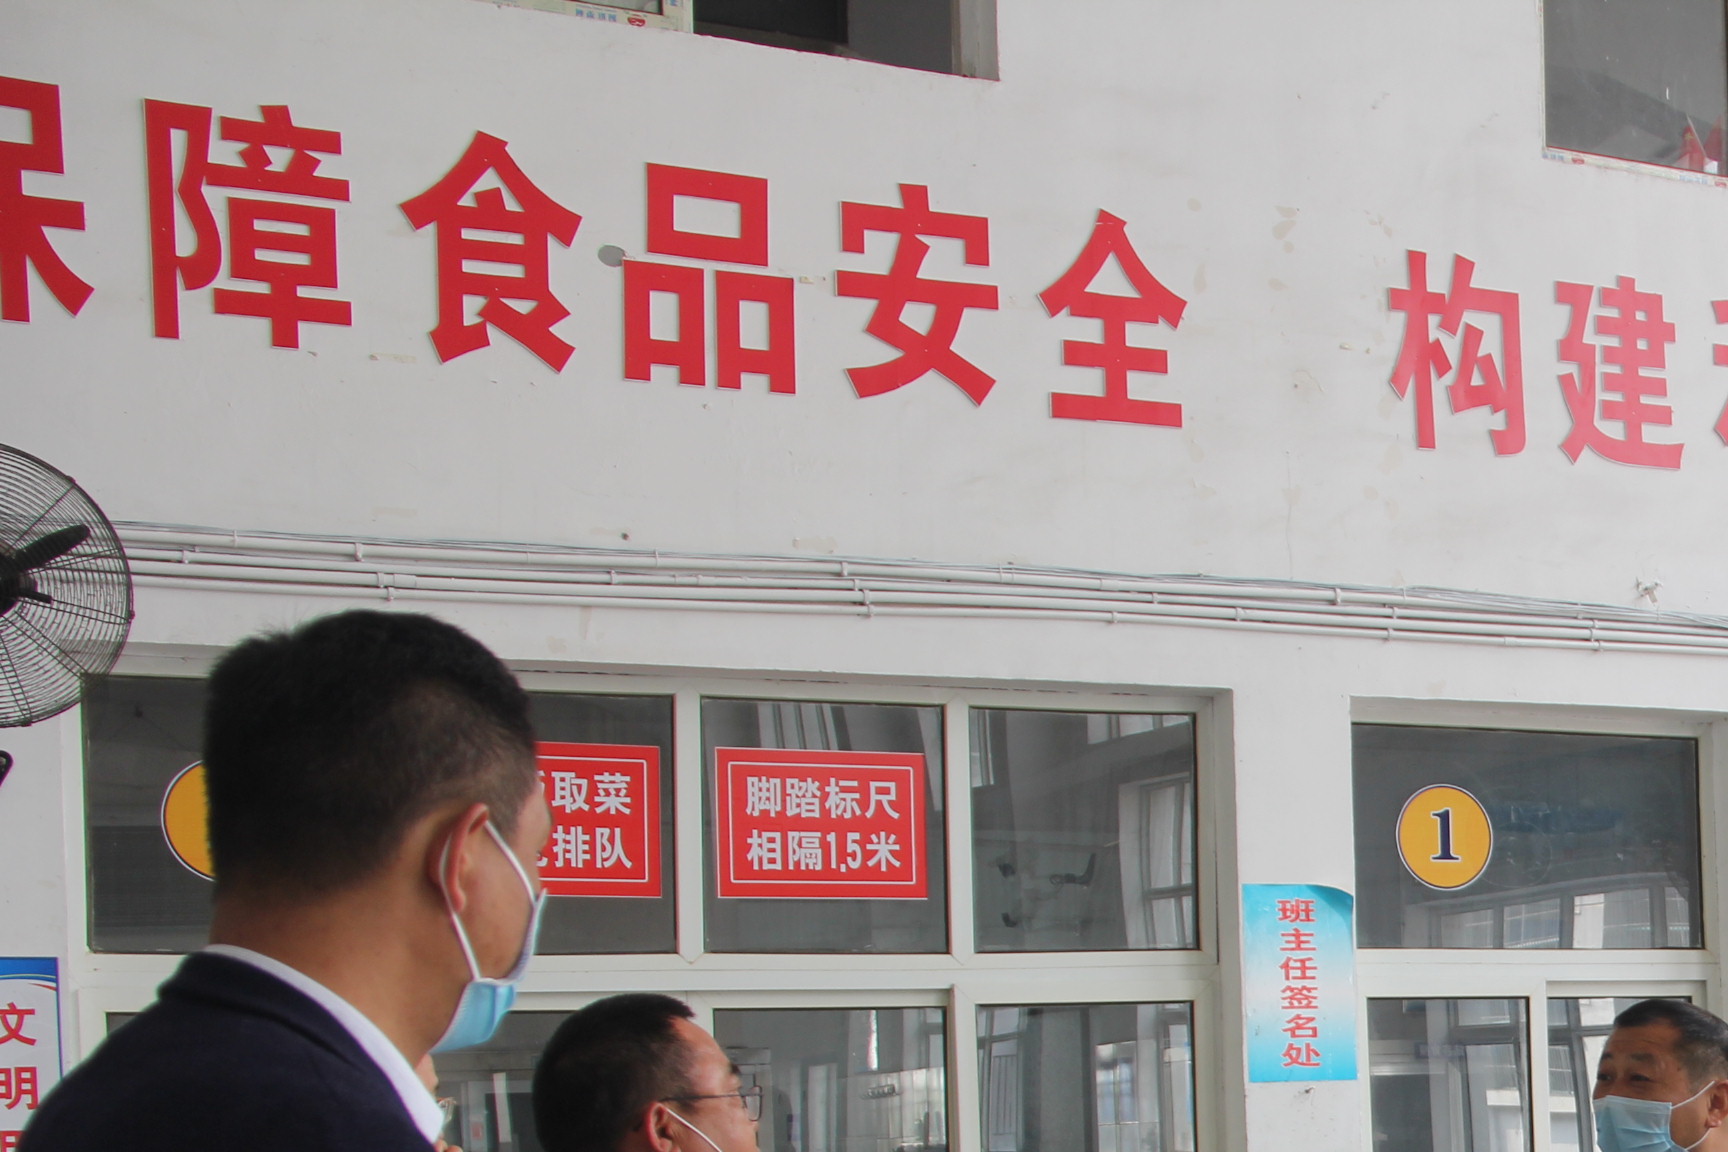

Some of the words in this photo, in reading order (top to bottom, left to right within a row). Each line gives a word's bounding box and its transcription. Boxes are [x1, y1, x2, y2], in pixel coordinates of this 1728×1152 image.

[538, 770, 632, 815] 取菜
[746, 776, 900, 819] 脚踏标尺
[537, 826, 633, 869] 排队
[746, 829, 901, 873] 相隔1.5米
[1430, 808, 1462, 862] 1
[1277, 898, 1321, 1069] 班主任签名处
